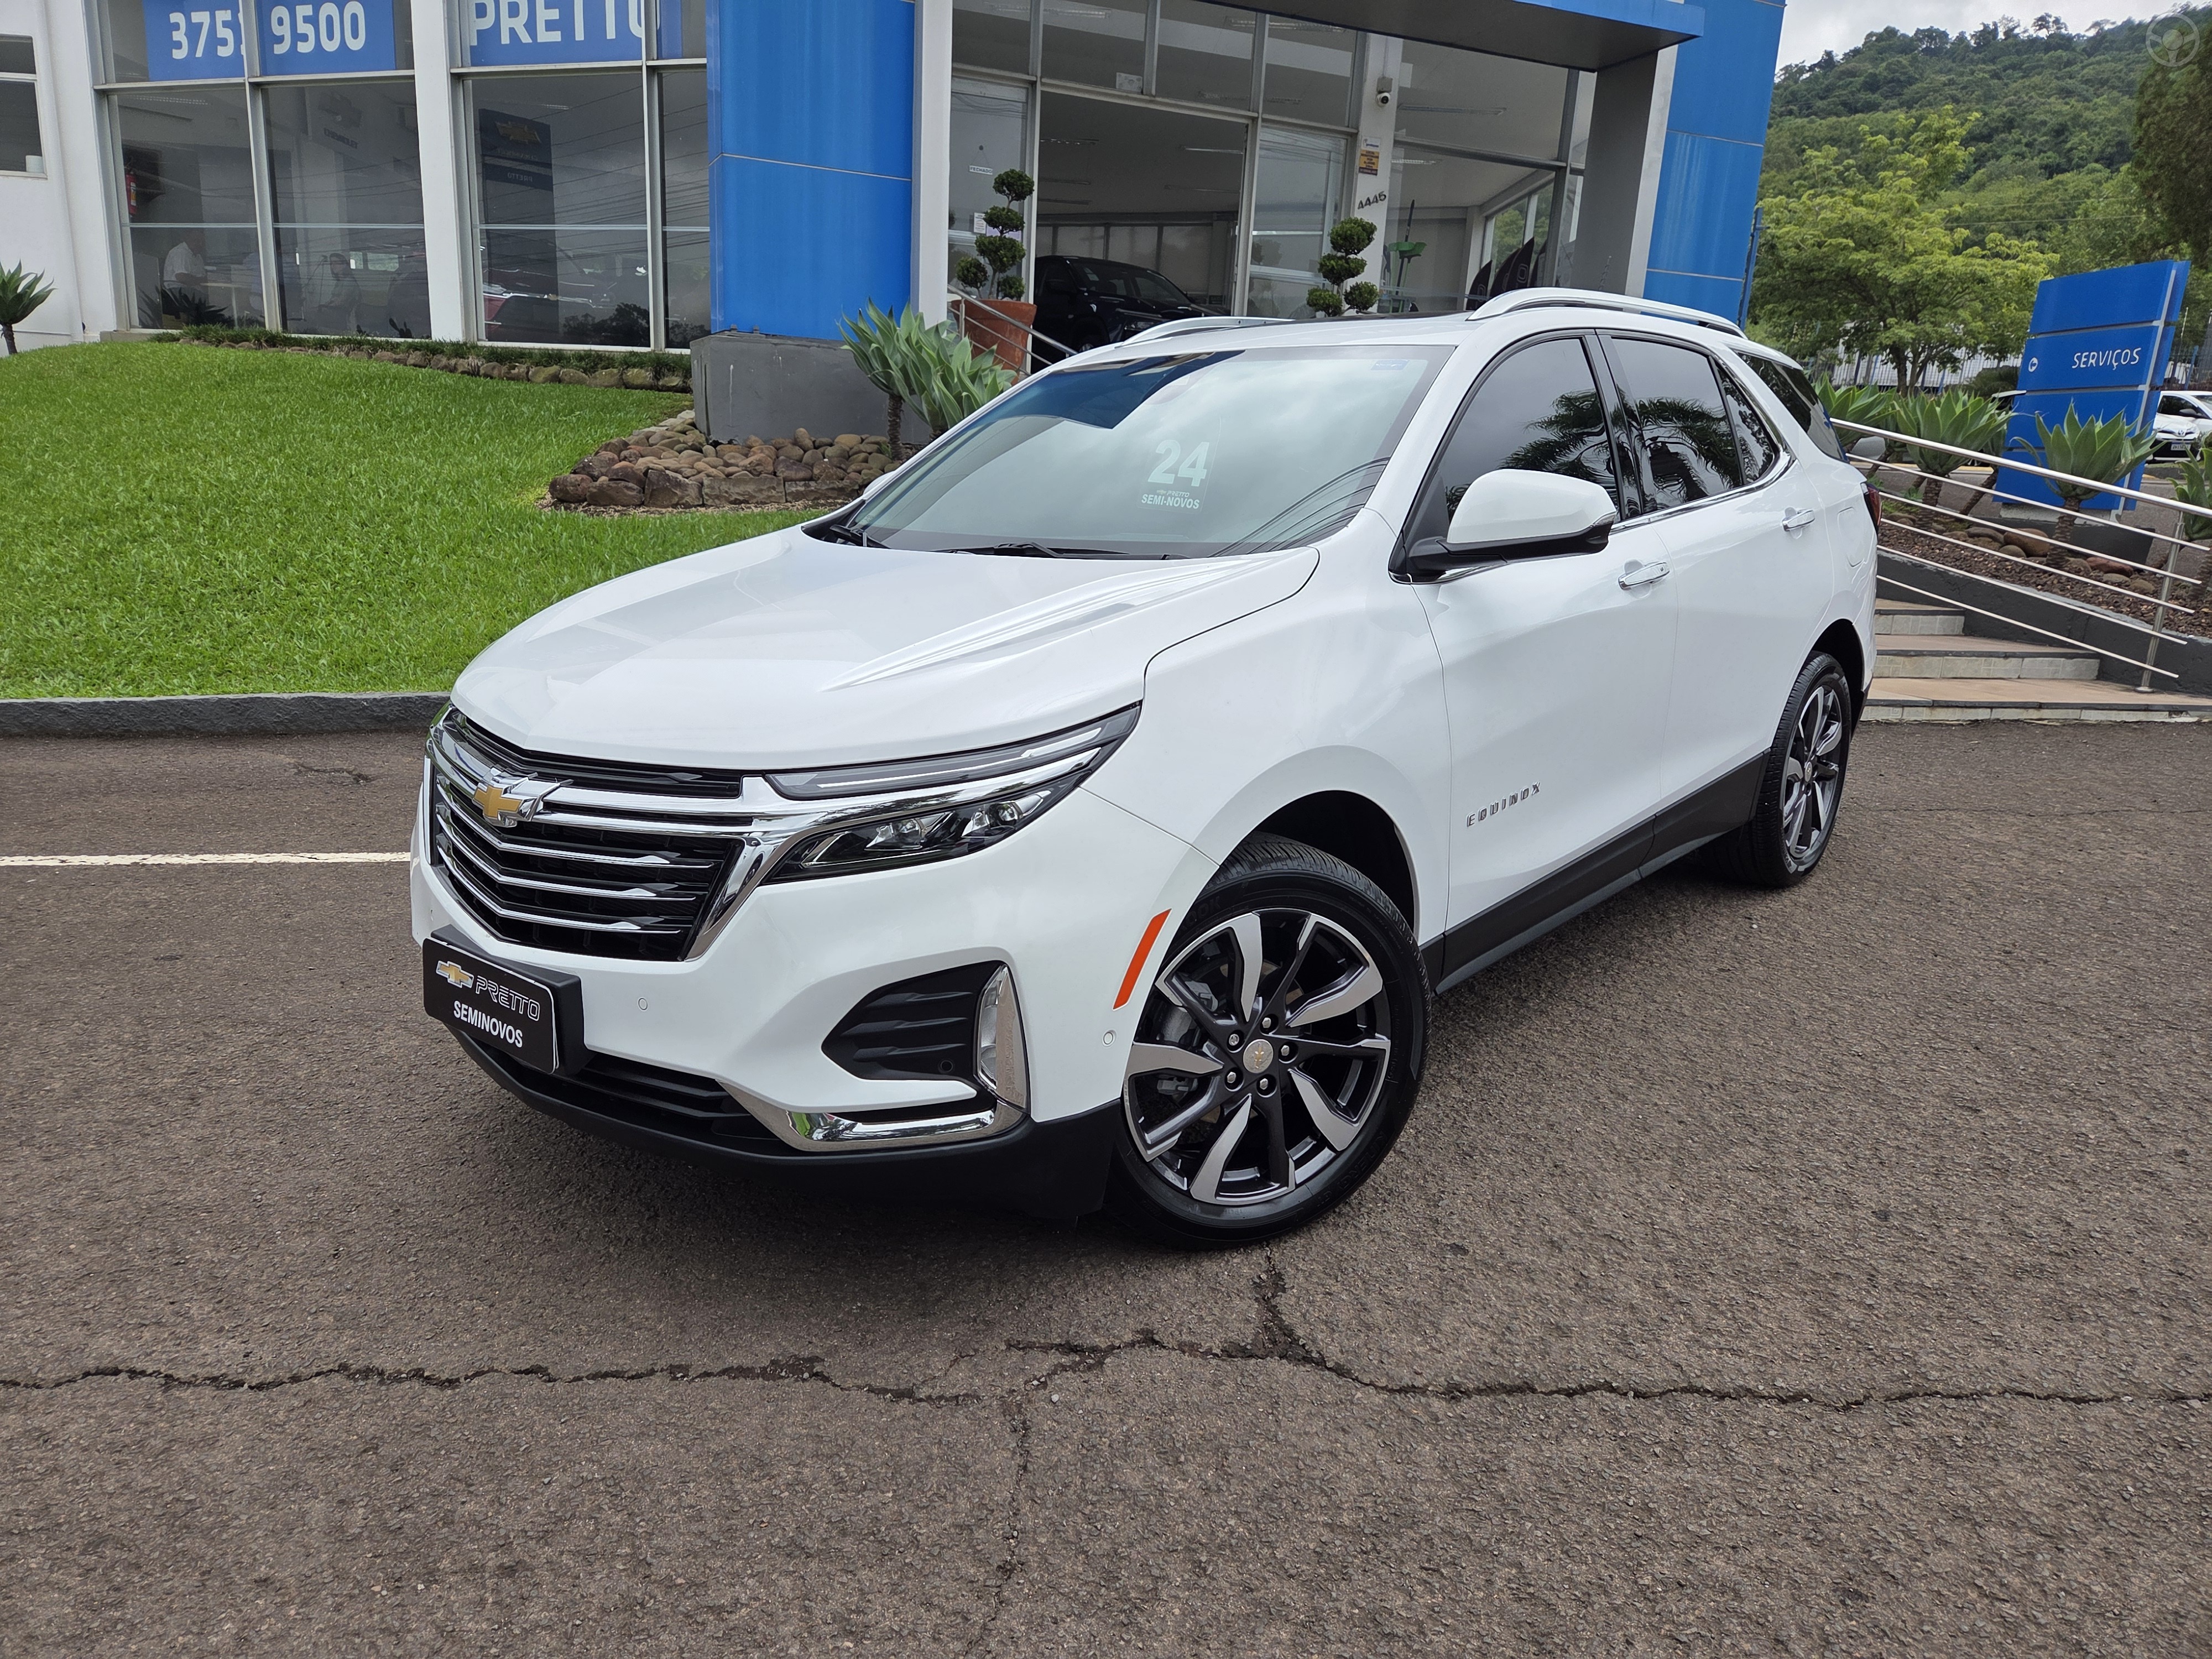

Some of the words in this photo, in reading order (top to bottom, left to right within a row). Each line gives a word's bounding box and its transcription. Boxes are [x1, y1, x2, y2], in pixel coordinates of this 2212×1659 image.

[270, 1, 366, 54] 9500
[1358, 190, 1386, 210] 4445
[2072, 347, 2141, 370] SERVIÇOS
[1147, 439, 1209, 487] 24
[1141, 493, 1199, 509] SEMI-NOVOS
[1467, 781, 1540, 827] EQUINOX
[475, 975, 541, 1021] PRETTO
[453, 1000, 523, 1048] SEMINOVOS
